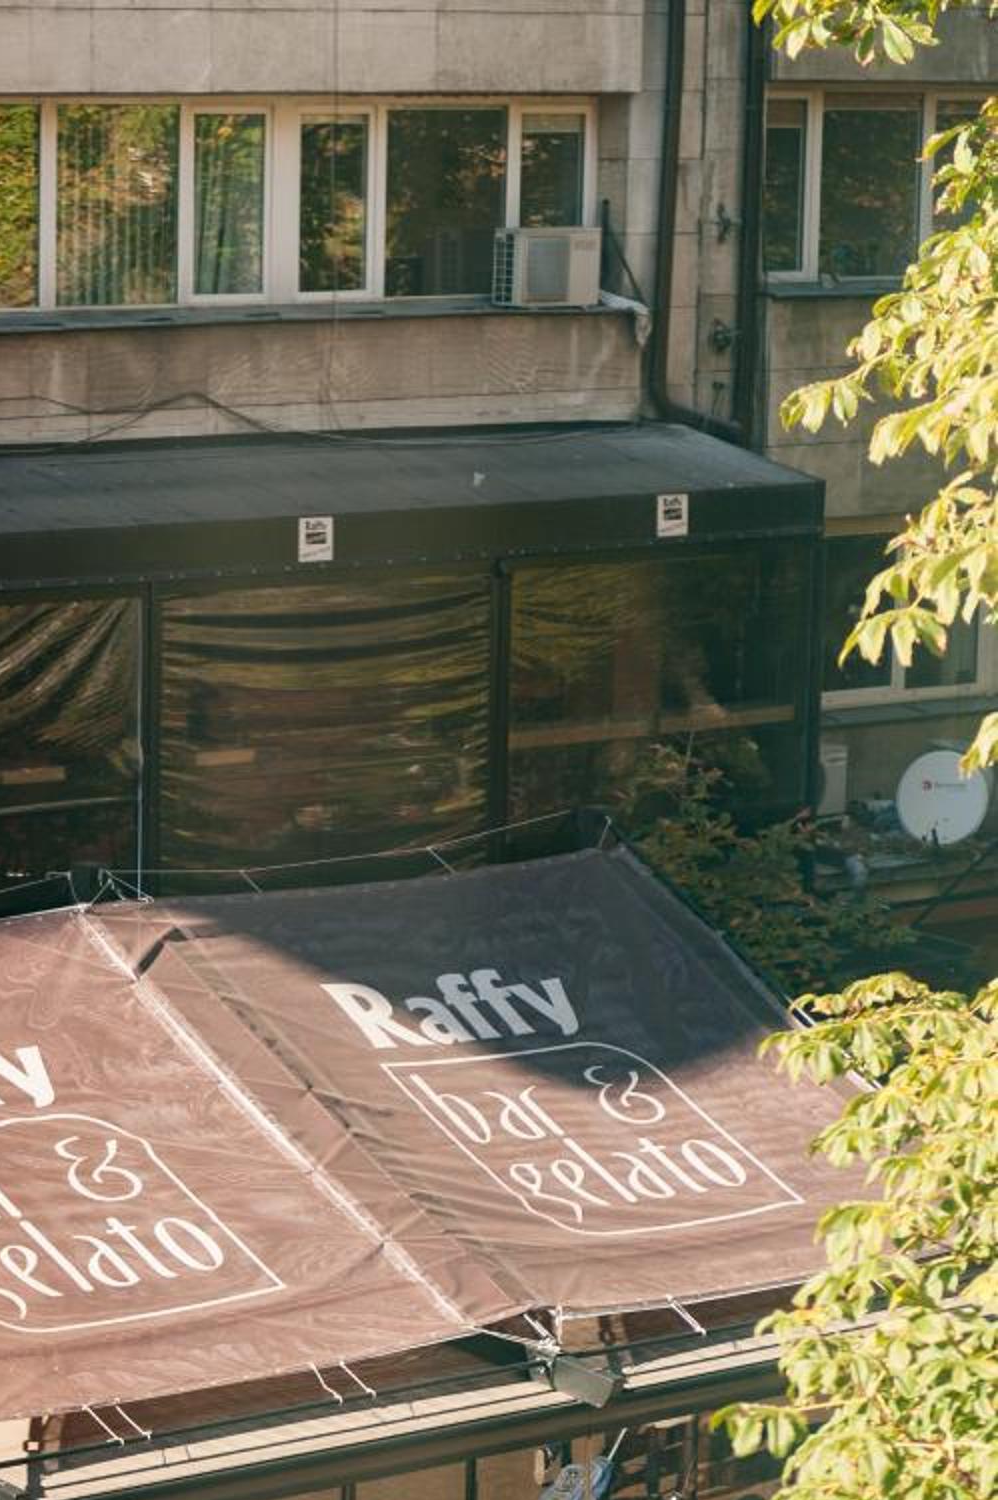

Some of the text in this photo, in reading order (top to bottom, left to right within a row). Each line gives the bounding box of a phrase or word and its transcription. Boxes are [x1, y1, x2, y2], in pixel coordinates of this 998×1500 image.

[320, 968, 580, 1049] Raffy
[409, 1065, 665, 1144] bar &
[54, 1135, 143, 1202] &
[509, 1136, 747, 1223] gelato
